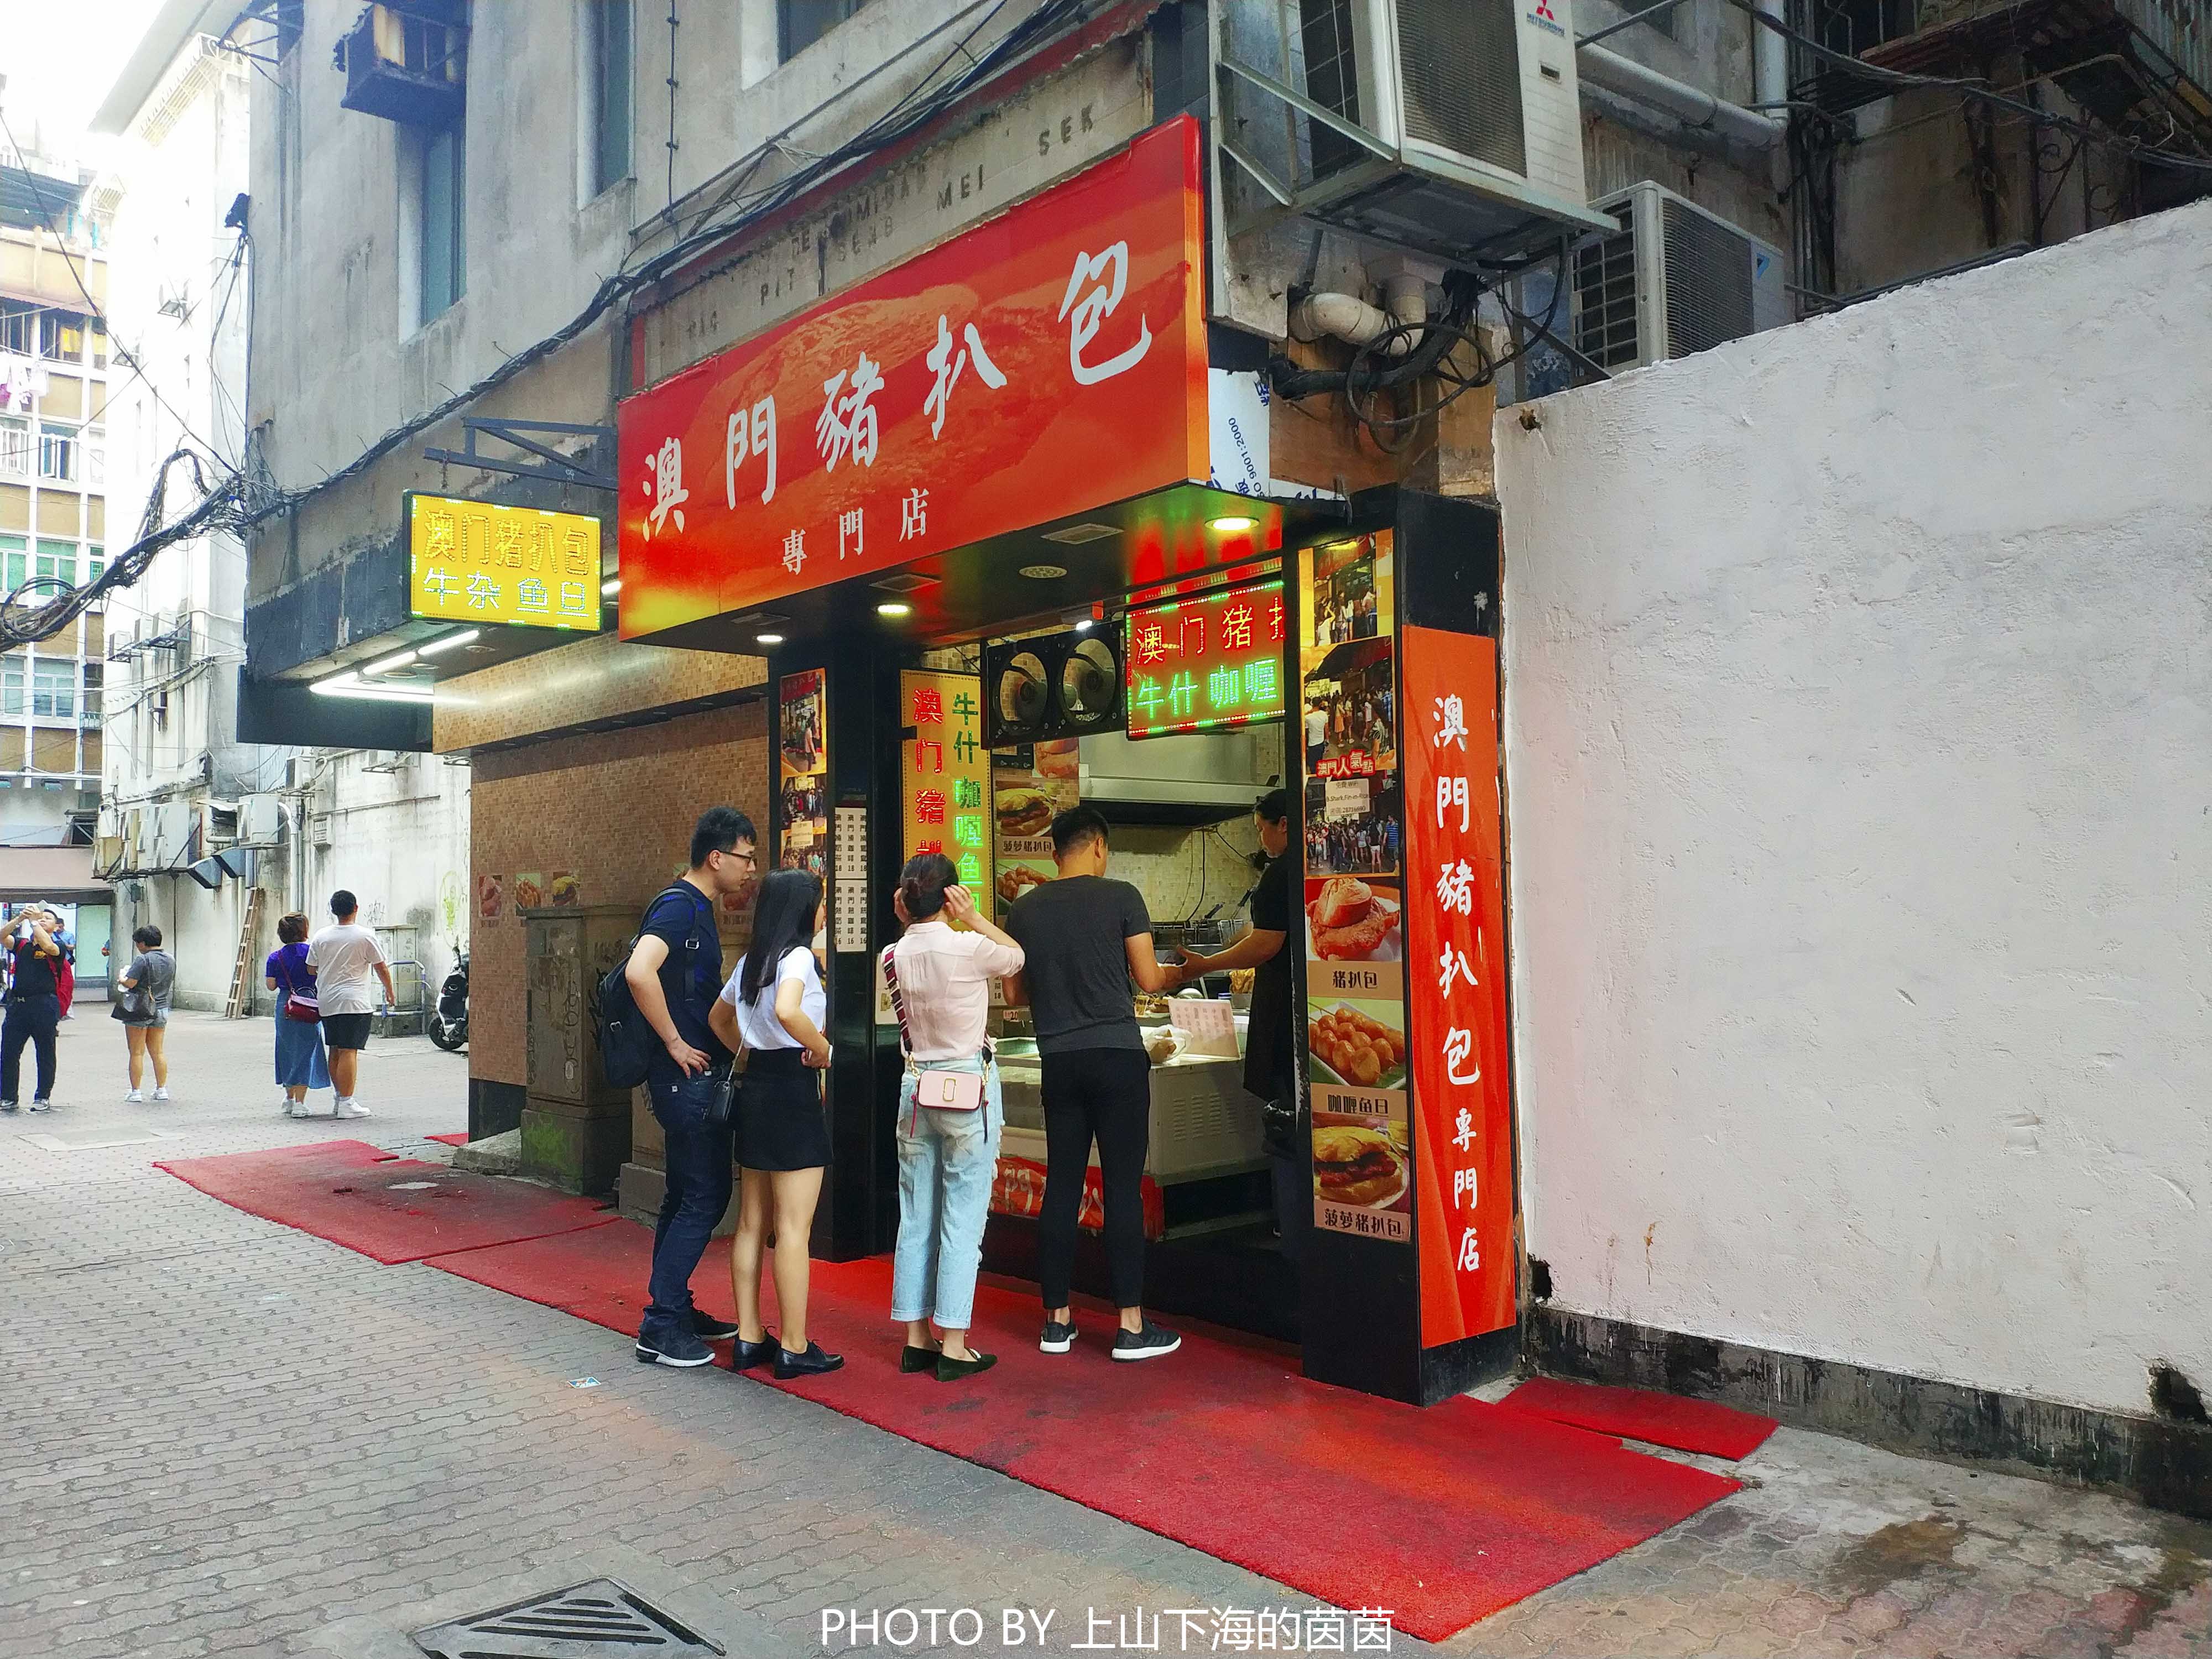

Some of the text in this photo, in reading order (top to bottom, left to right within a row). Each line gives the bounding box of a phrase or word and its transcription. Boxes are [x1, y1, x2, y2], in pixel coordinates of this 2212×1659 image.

[936, 164, 984, 212] MEI
[1039, 102, 1094, 156] SEK
[424, 509, 589, 576] 澳门猪扒包
[781, 487, 930, 575] 專門店
[1136, 659, 1278, 719] 牛什咖喱
[913, 689, 946, 854] 澳门猪
